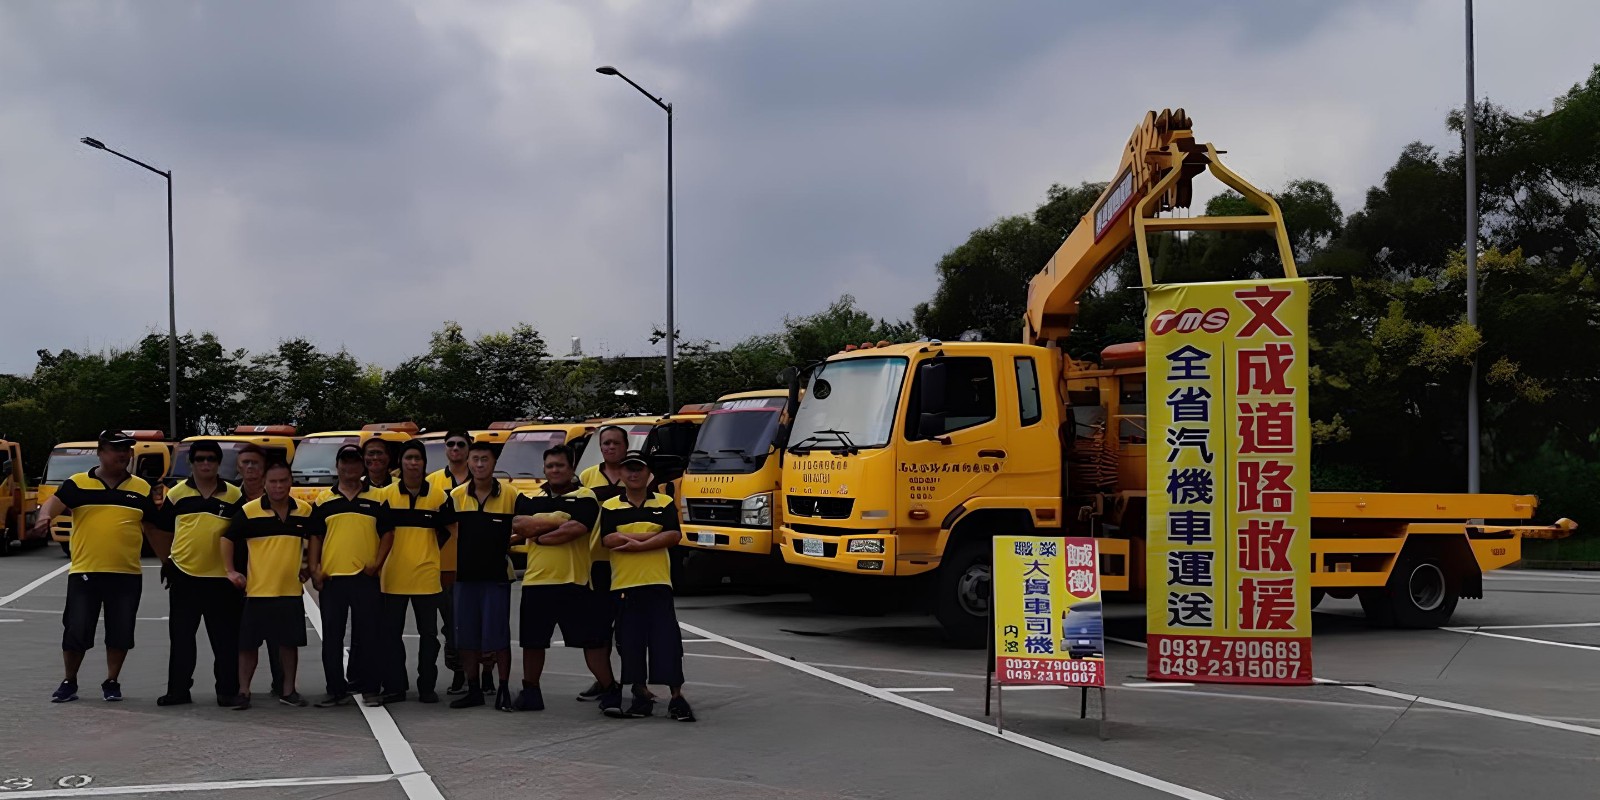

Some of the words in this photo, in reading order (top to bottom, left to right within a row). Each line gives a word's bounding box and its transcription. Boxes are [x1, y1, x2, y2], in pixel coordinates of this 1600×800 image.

[1153, 309, 1229, 334] TMS
[1235, 286, 1295, 630] 文成道路救援
[1166, 345, 1214, 627] 全省汽機車運送
[1159, 639, 1301, 659] 0937-790663
[1159, 658, 1302, 679] 049-2315067
